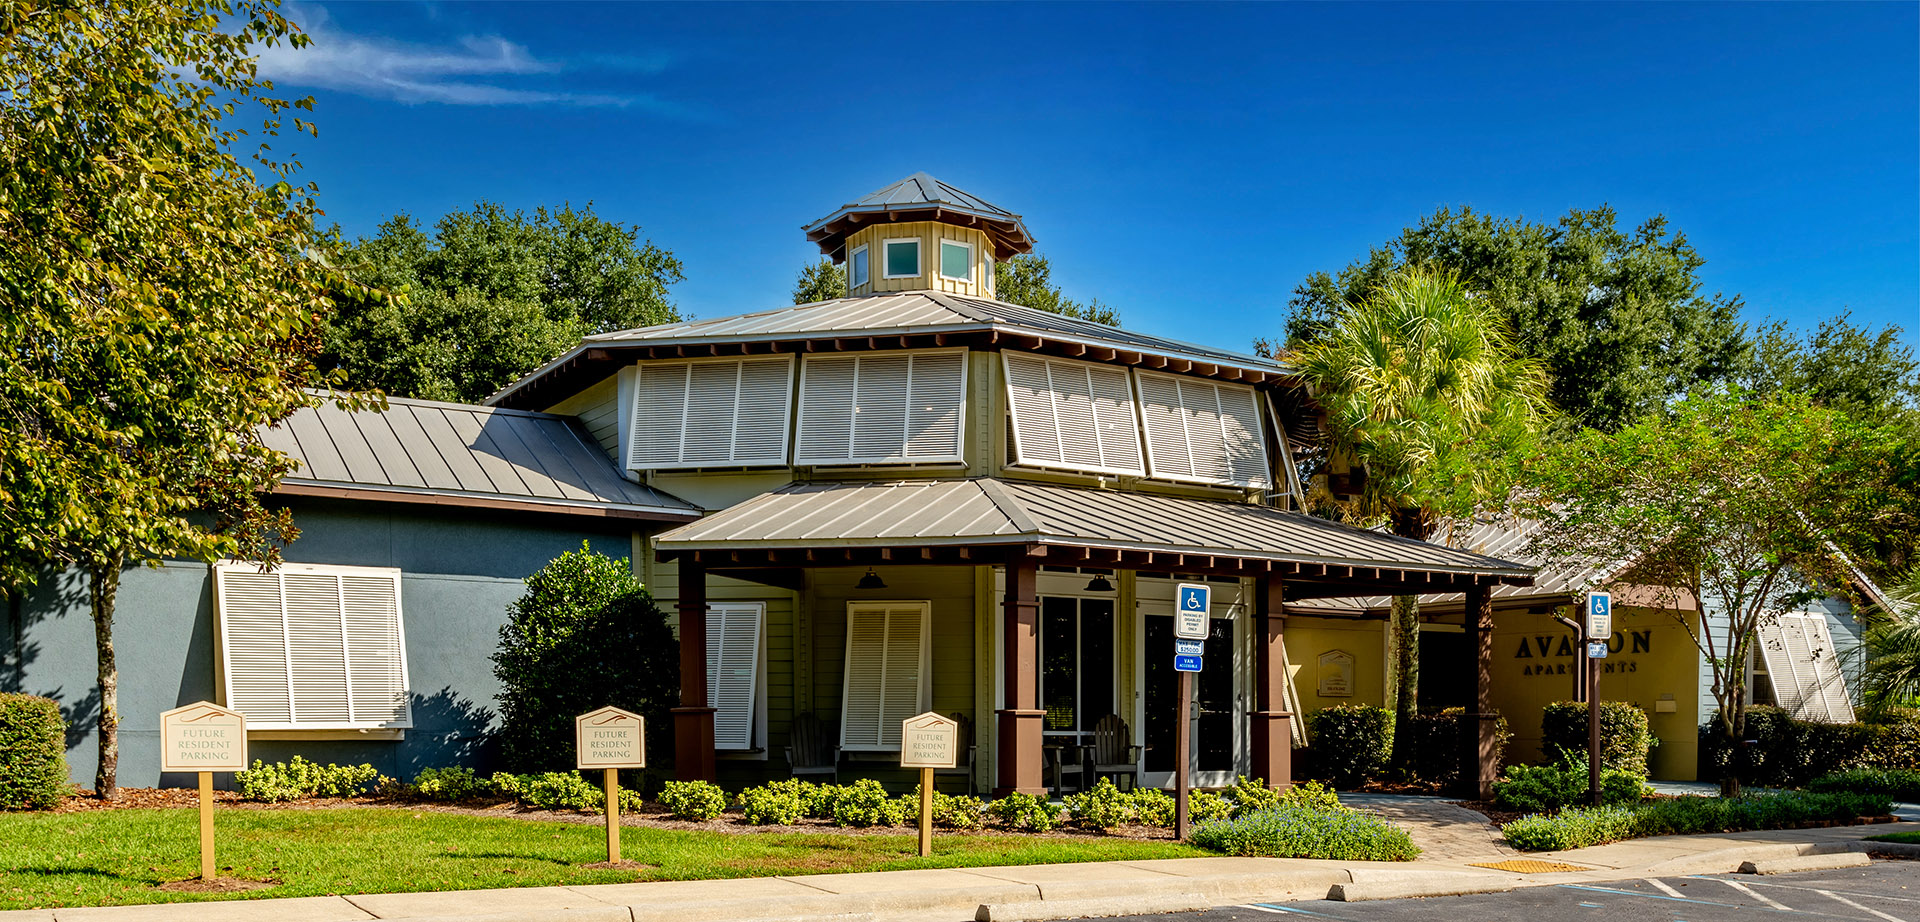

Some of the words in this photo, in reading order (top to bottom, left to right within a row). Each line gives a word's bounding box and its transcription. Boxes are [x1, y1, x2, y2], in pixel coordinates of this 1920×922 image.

[1514, 630, 1652, 658] AVAON
[183, 729, 225, 738] FUTURE
[178, 740, 231, 749] RESIDENT
[590, 740, 632, 748] RESIDENT
[912, 742, 946, 750] RESIDENT
[181, 751, 229, 760] PARKING
[592, 750, 631, 758] PARKING
[914, 751, 945, 759] PARKING
